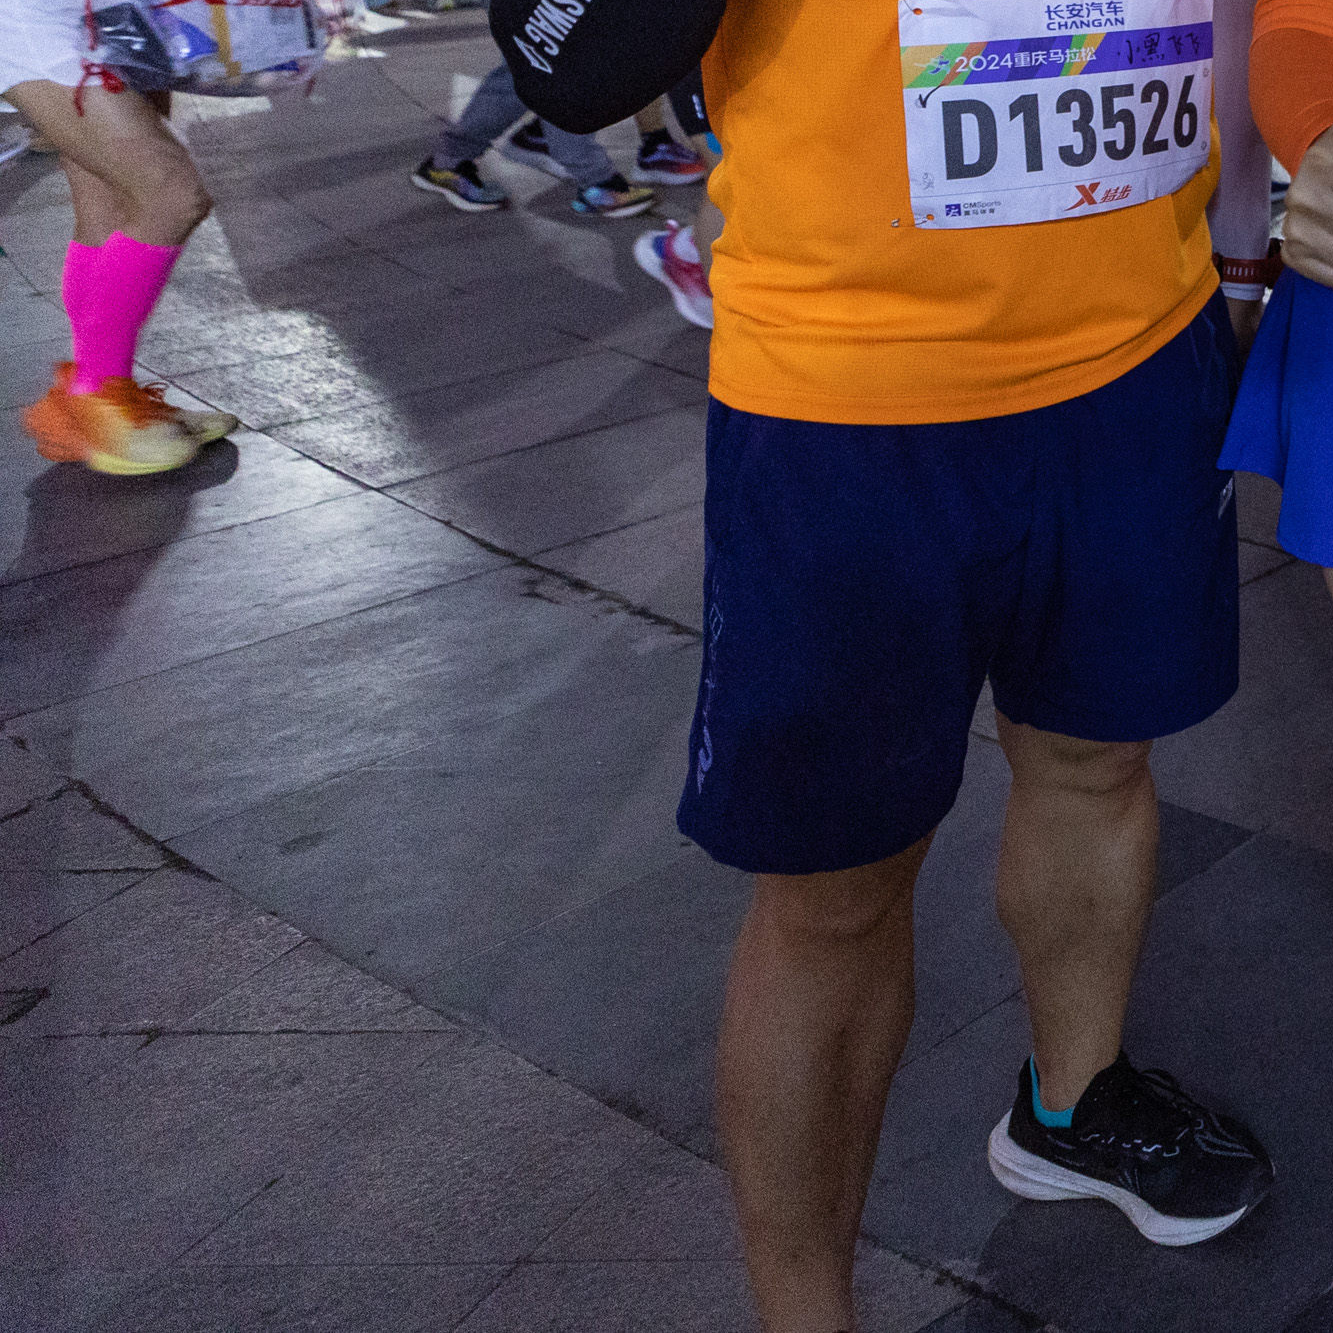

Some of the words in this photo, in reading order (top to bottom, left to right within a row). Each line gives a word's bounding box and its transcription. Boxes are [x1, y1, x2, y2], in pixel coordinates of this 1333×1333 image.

[1045, 0, 1124, 21] 长安汽车
[1046, 17, 1125, 31] CHANGAN
[955, 46, 1097, 73] 2024重庆马拉松
[942, 74, 1199, 180] D13526
